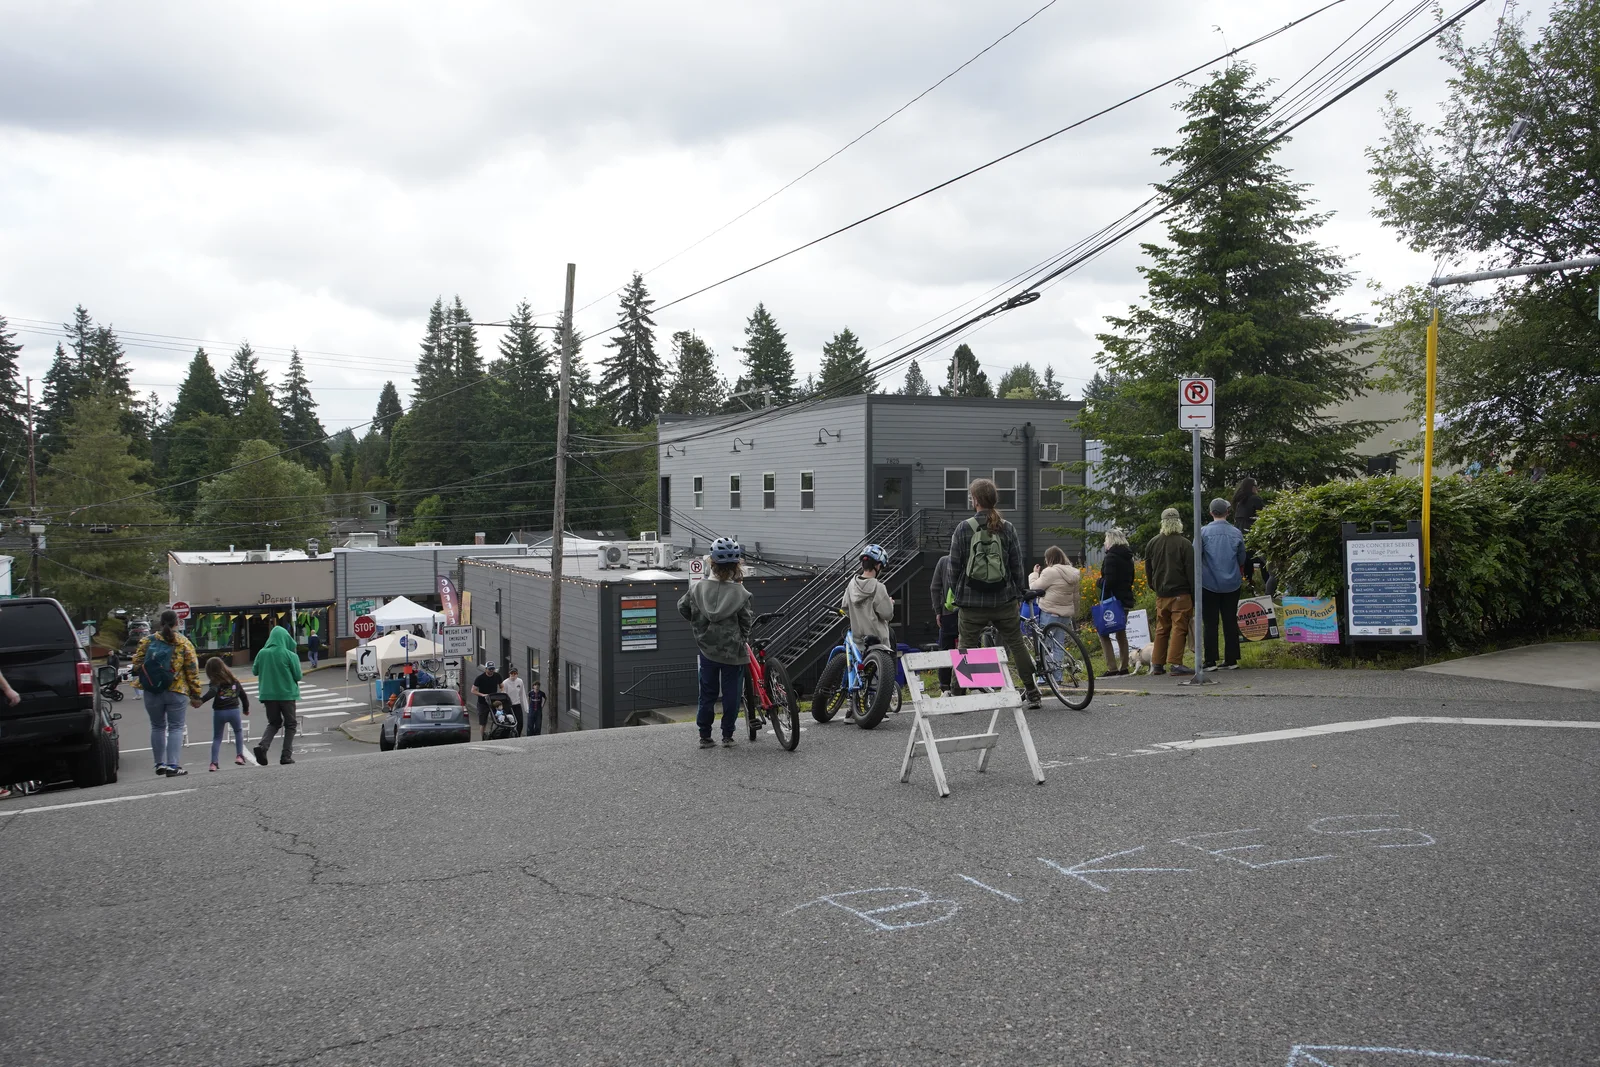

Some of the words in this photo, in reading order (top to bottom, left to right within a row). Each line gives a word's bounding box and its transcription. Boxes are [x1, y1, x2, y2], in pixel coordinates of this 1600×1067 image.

[1237, 612, 1256, 620] ARAGE
[1257, 608, 1272, 616] SALE
[1285, 608, 1310, 617] Family
[1310, 604, 1334, 617] Picnics
[354, 623, 374, 632] STOP
[786, 813, 1436, 932] BIKES
